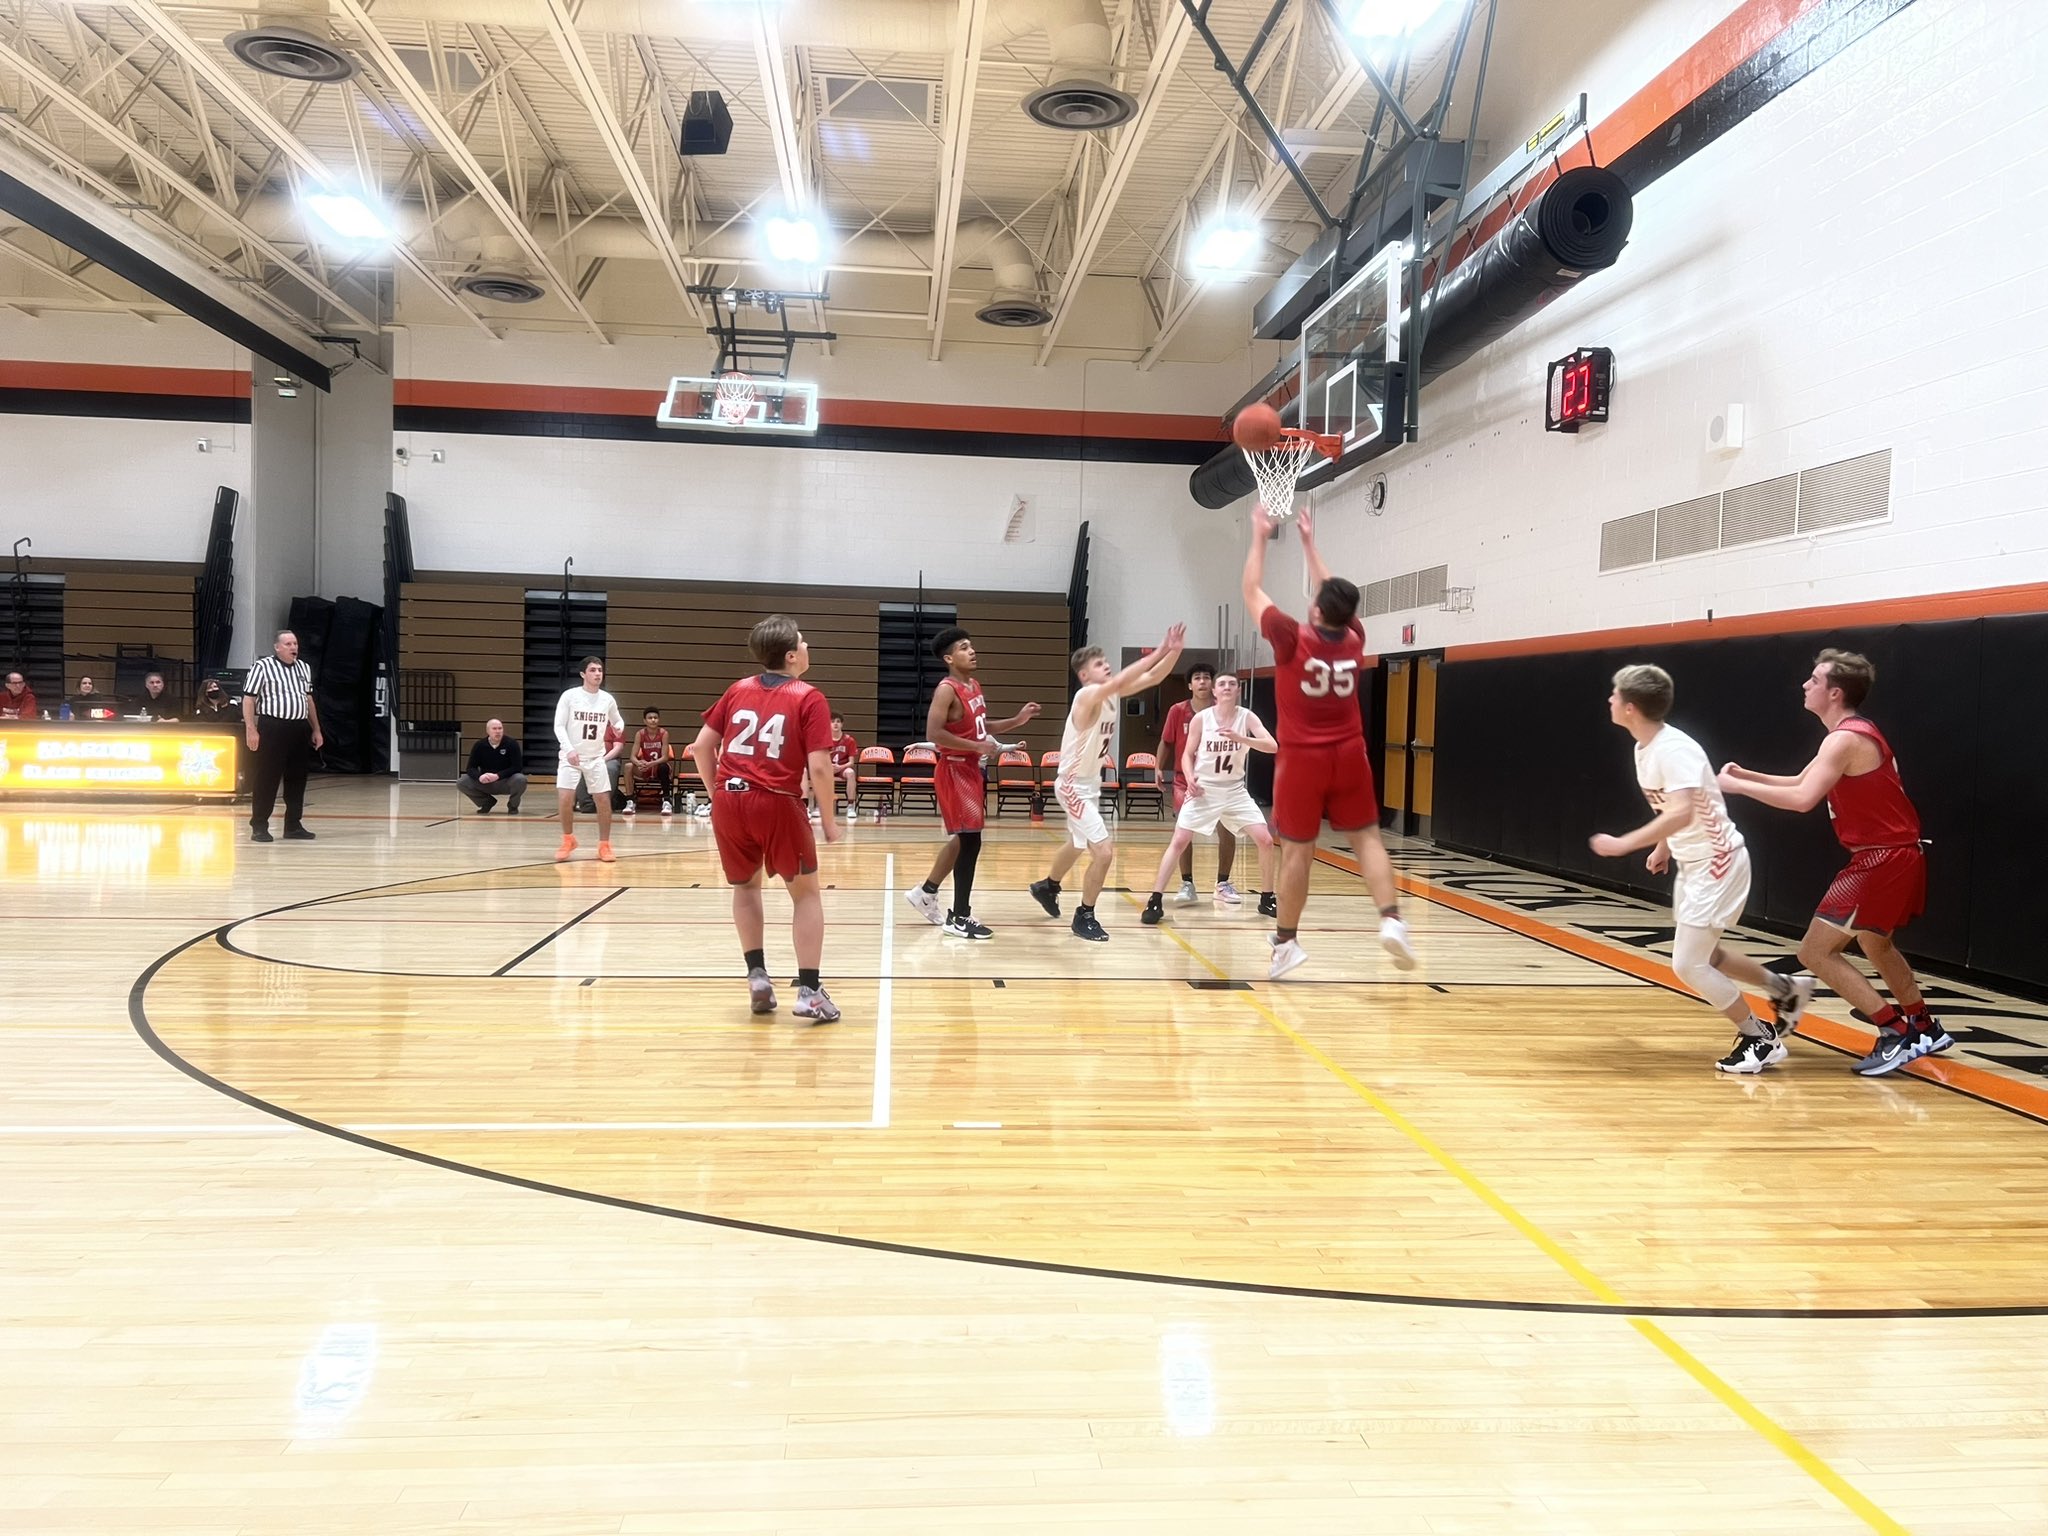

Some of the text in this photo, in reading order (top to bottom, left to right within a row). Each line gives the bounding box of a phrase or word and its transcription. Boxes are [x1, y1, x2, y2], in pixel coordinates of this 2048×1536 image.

[1300, 656, 1358, 698] 35
[374, 676, 387, 717] UCS
[573, 710, 606, 723] KNIGHTS
[582, 724, 598, 740] 13
[726, 708, 786, 760] 24
[1214, 755, 1234, 775] 14
